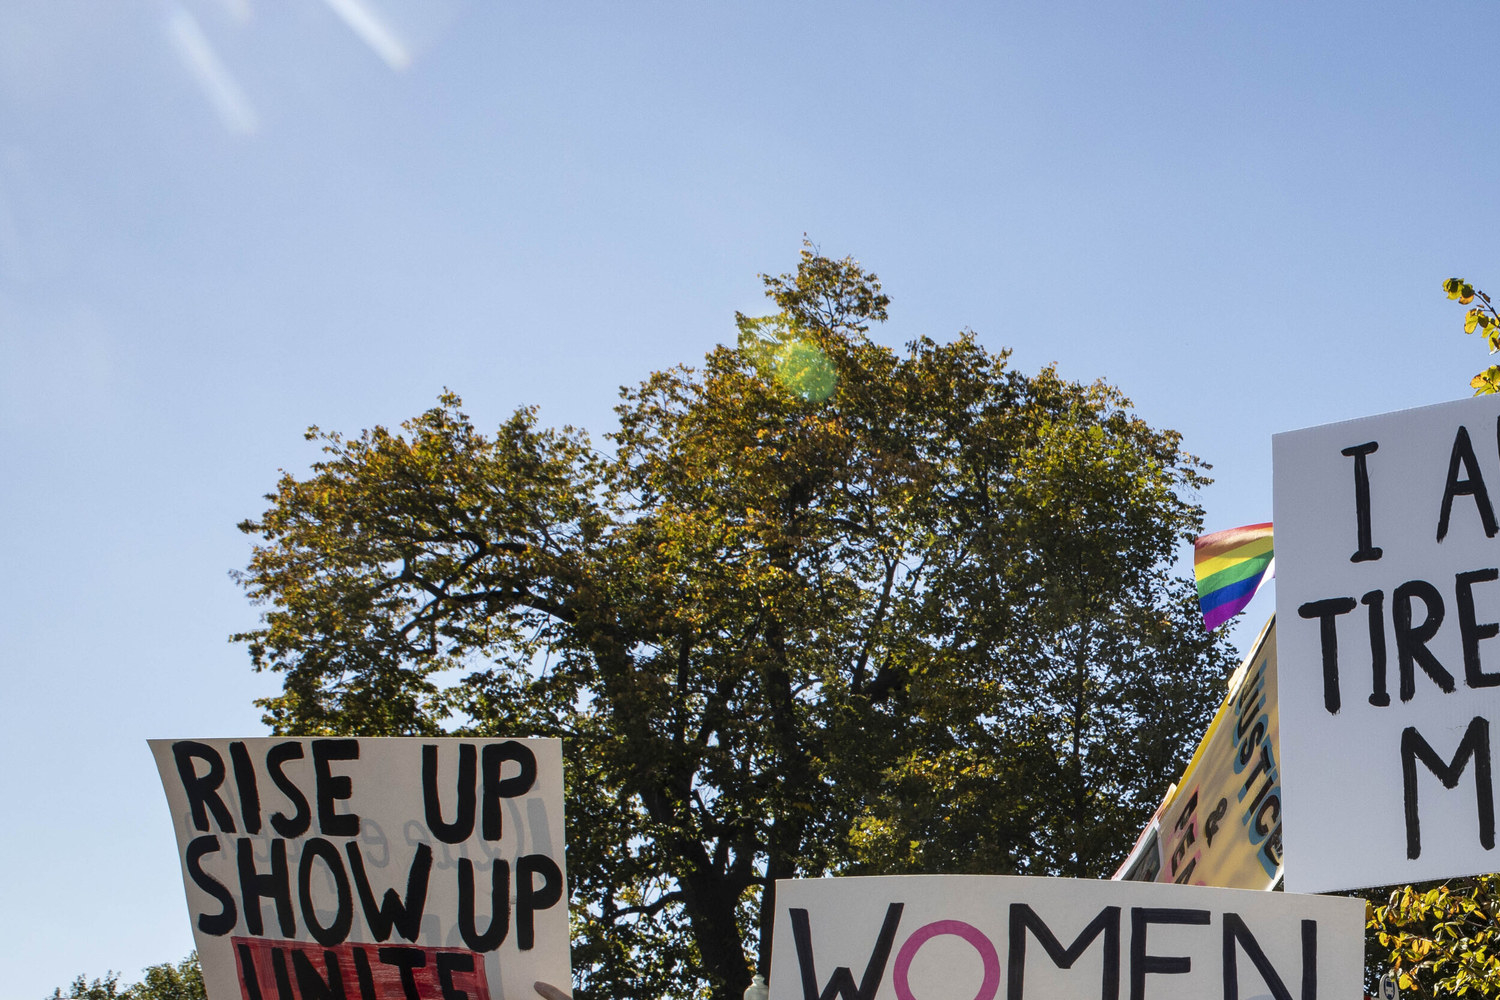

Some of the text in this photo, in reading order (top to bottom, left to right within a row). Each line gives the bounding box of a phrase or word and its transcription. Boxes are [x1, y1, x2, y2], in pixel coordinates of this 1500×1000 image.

[1340, 441, 1383, 563] I
[172, 739, 537, 844] RISE UP
[186, 834, 563, 954] SHOW UP
